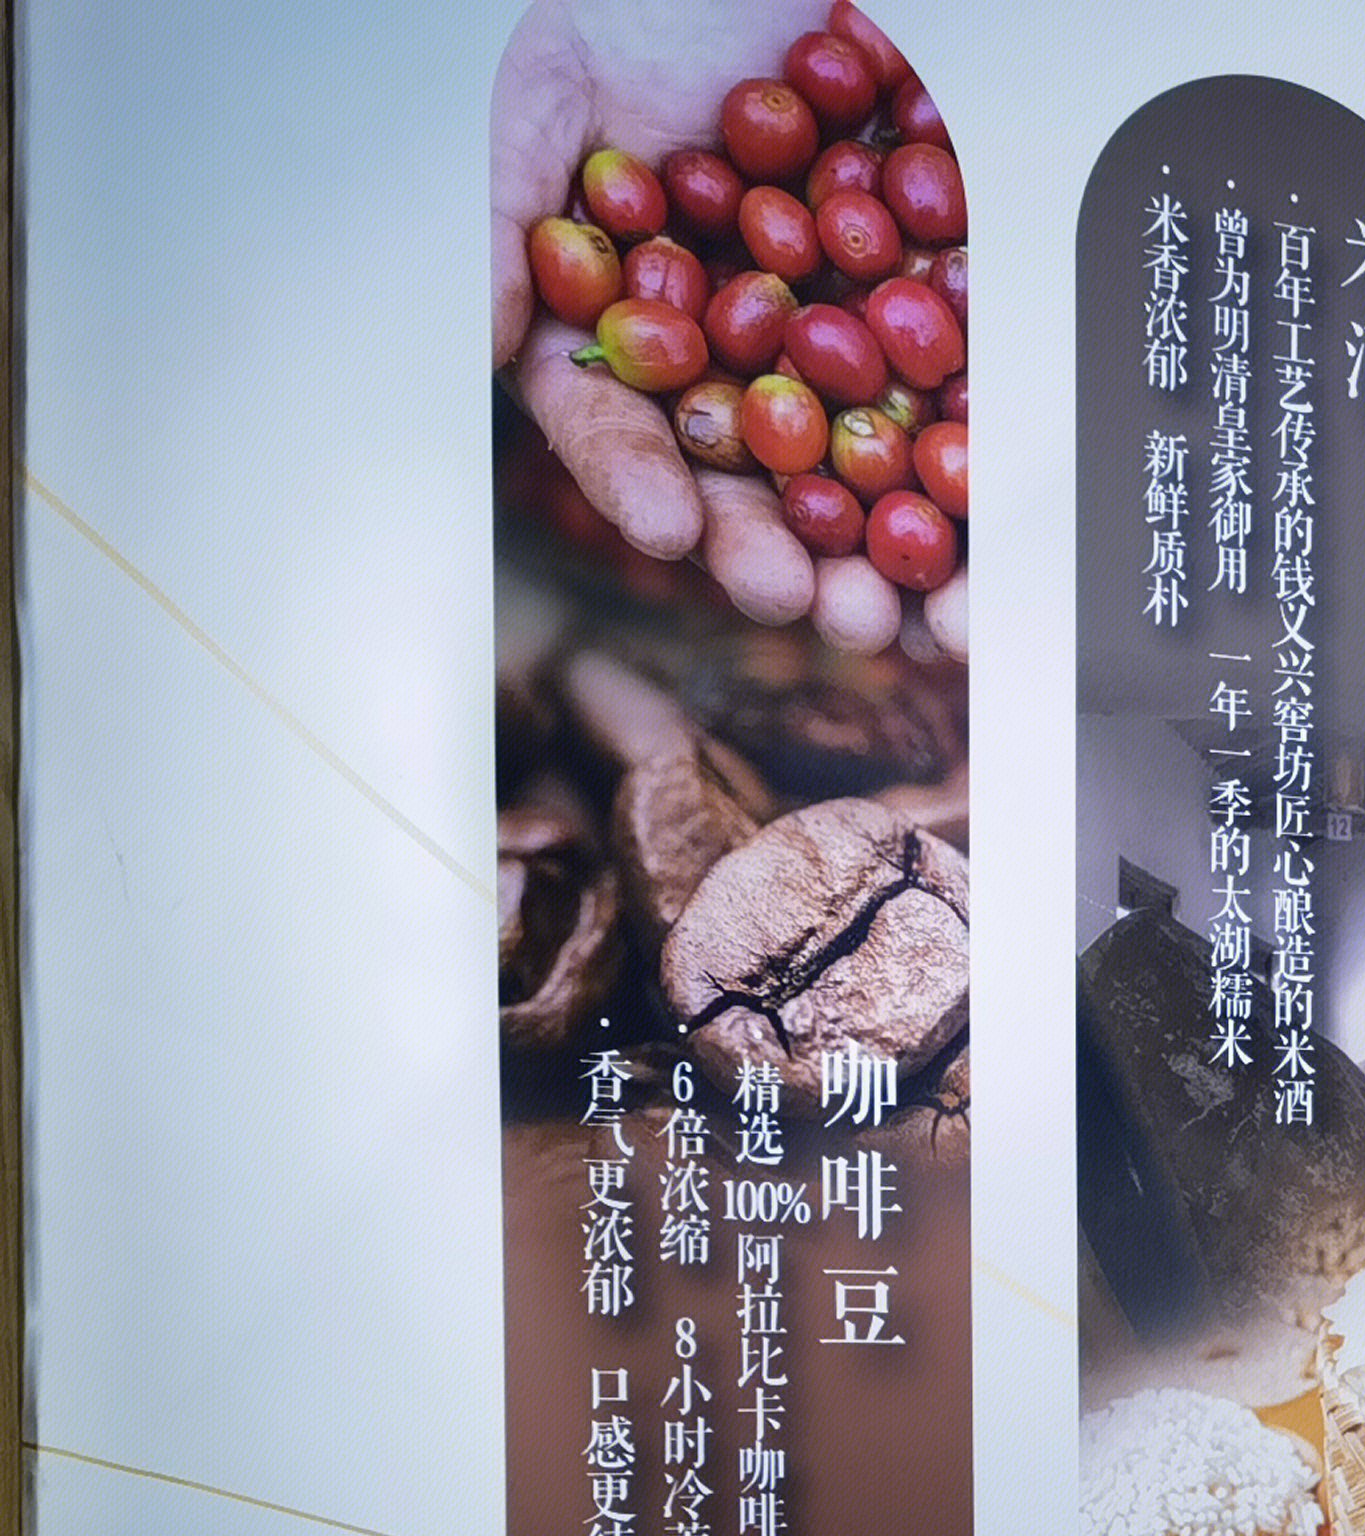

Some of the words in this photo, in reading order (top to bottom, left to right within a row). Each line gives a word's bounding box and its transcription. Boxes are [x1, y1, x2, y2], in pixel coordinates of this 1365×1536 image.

[1142, 193, 1189, 391] 米香浓郁
[1208, 208, 1252, 594] 曾为明清皇家御用
[1142, 430, 1189, 627] 新鲜质朴
[1209, 652, 1253, 1068] 一年一季的太湖糯米
[579, 1049, 634, 1316] 香气更浓郁
[657, 1061, 711, 1266] 6倍浓缩
[820, 1036, 905, 1346] 咖啡豆
